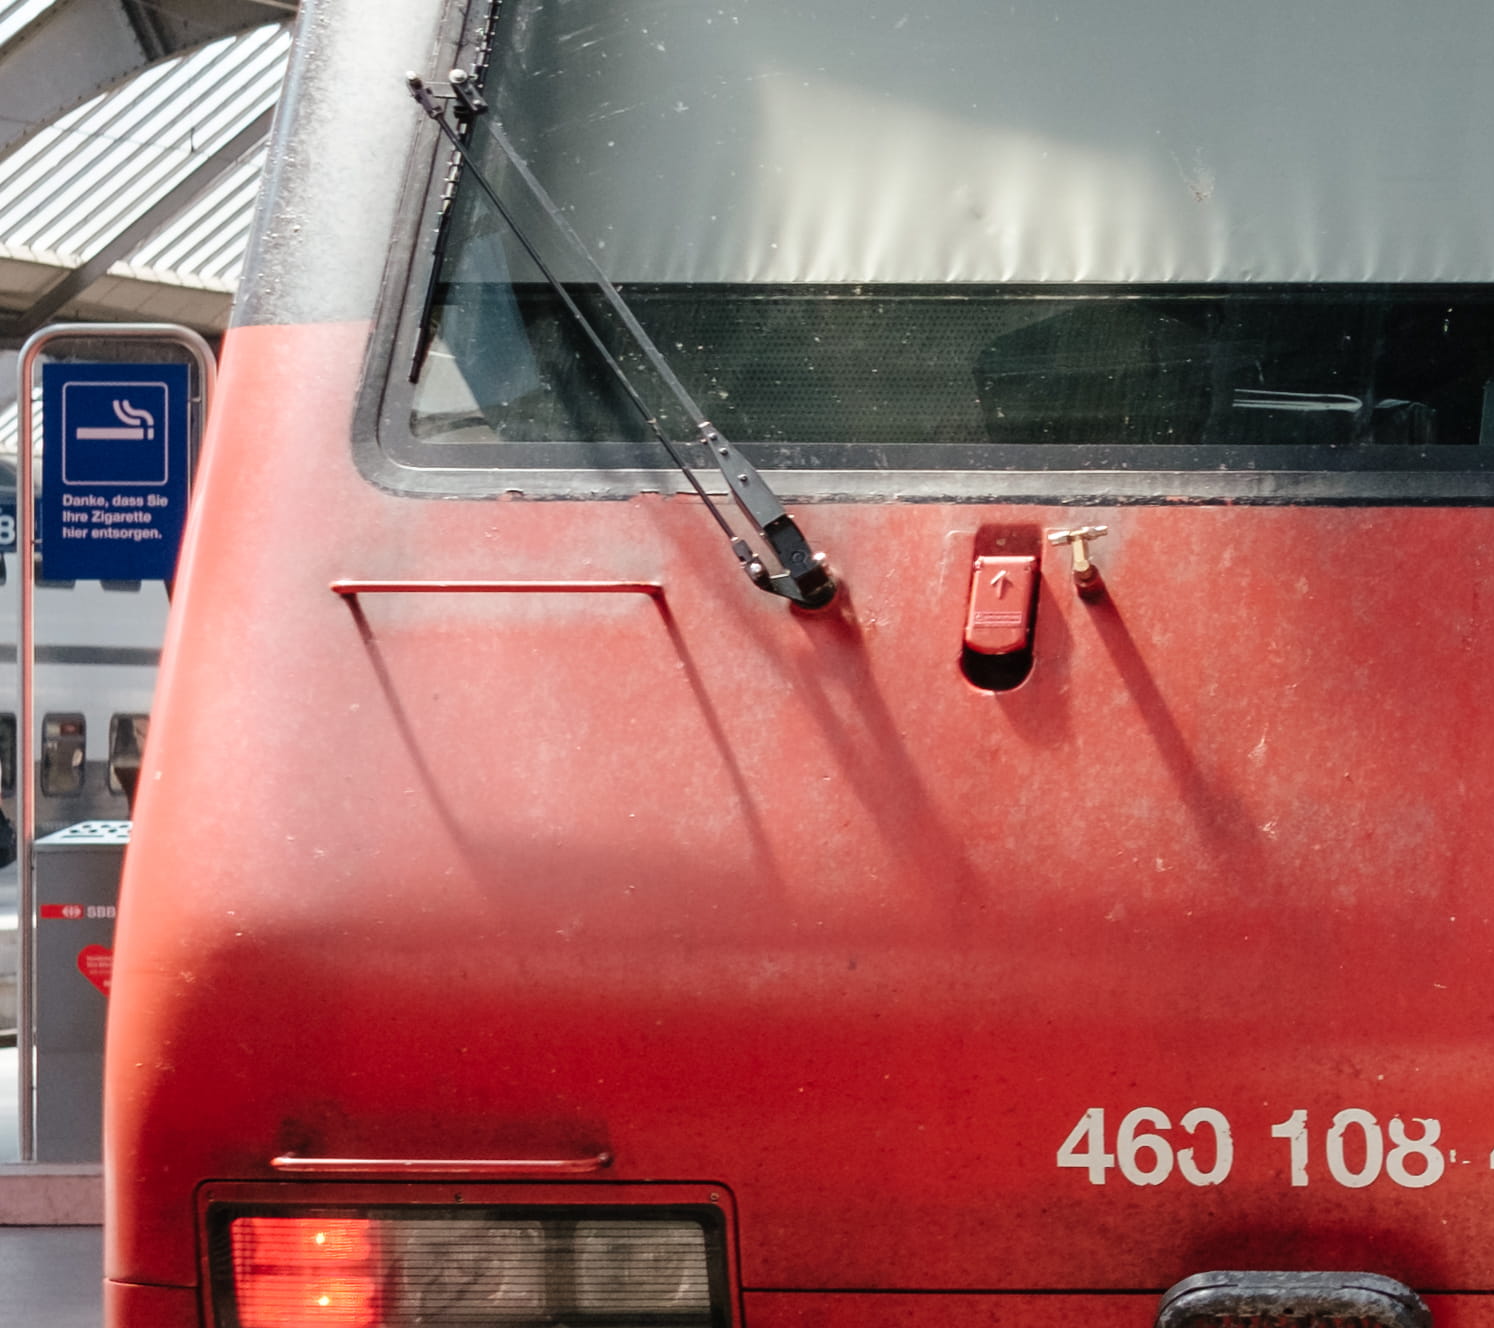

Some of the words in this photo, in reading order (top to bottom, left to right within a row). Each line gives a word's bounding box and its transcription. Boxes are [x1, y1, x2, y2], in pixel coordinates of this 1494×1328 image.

[62, 493, 110, 508] Danke,
[111, 493, 145, 507] dass
[146, 493, 169, 507] Sie
[62, 510, 89, 523] Ihre
[91, 510, 152, 525] Zigarette
[62, 526, 89, 539] hier
[91, 527, 163, 542] entsorgen.
[86, 905, 116, 919] SBB
[1056, 1106, 1235, 1187] 460
